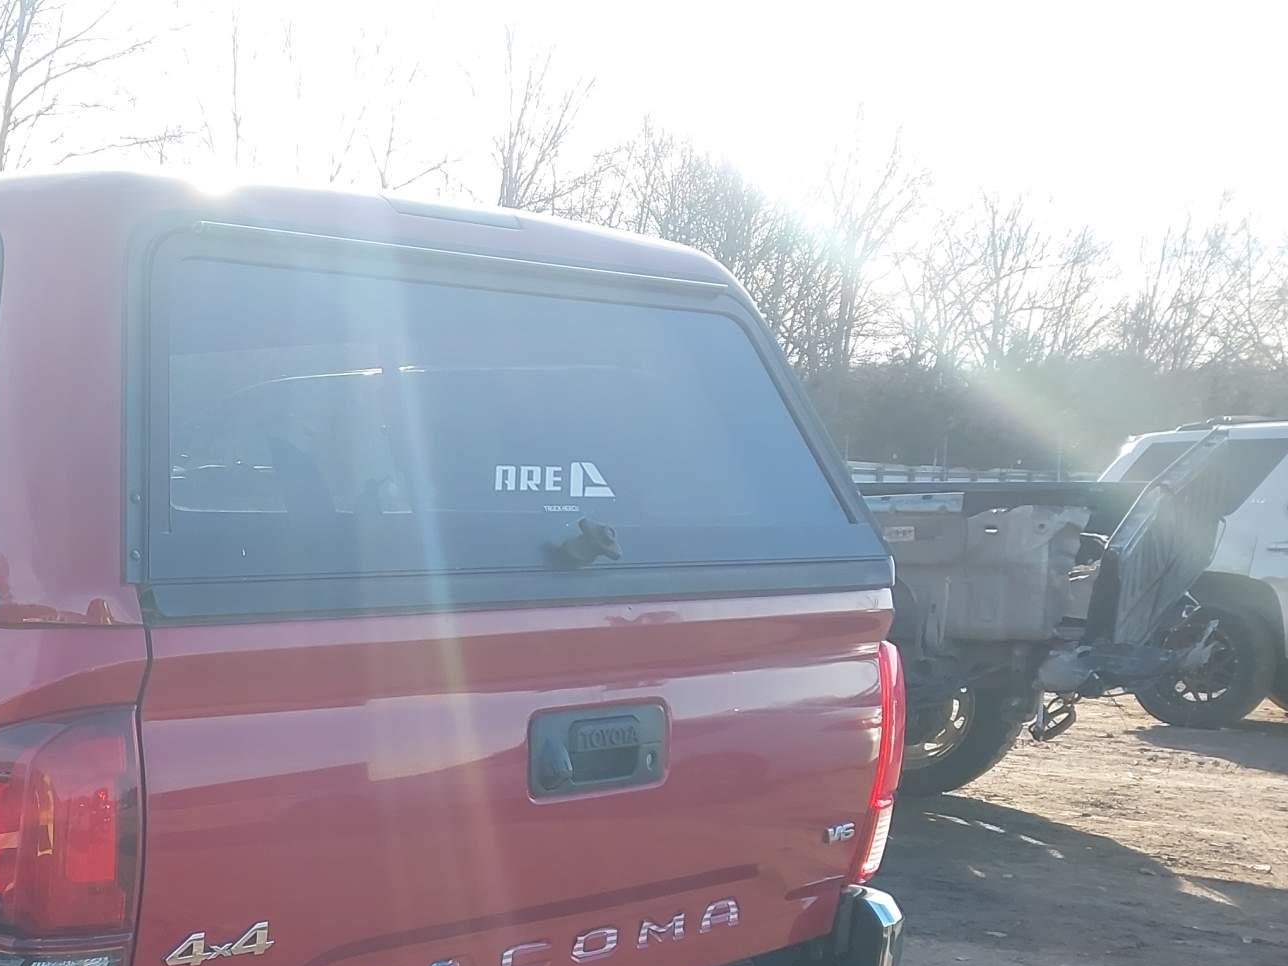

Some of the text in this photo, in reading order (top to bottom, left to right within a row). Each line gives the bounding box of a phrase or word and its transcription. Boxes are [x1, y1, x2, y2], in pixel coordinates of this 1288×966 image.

[495, 465, 562, 491] ARE
[577, 727, 639, 751] TOYOTA
[826, 823, 855, 842] V6
